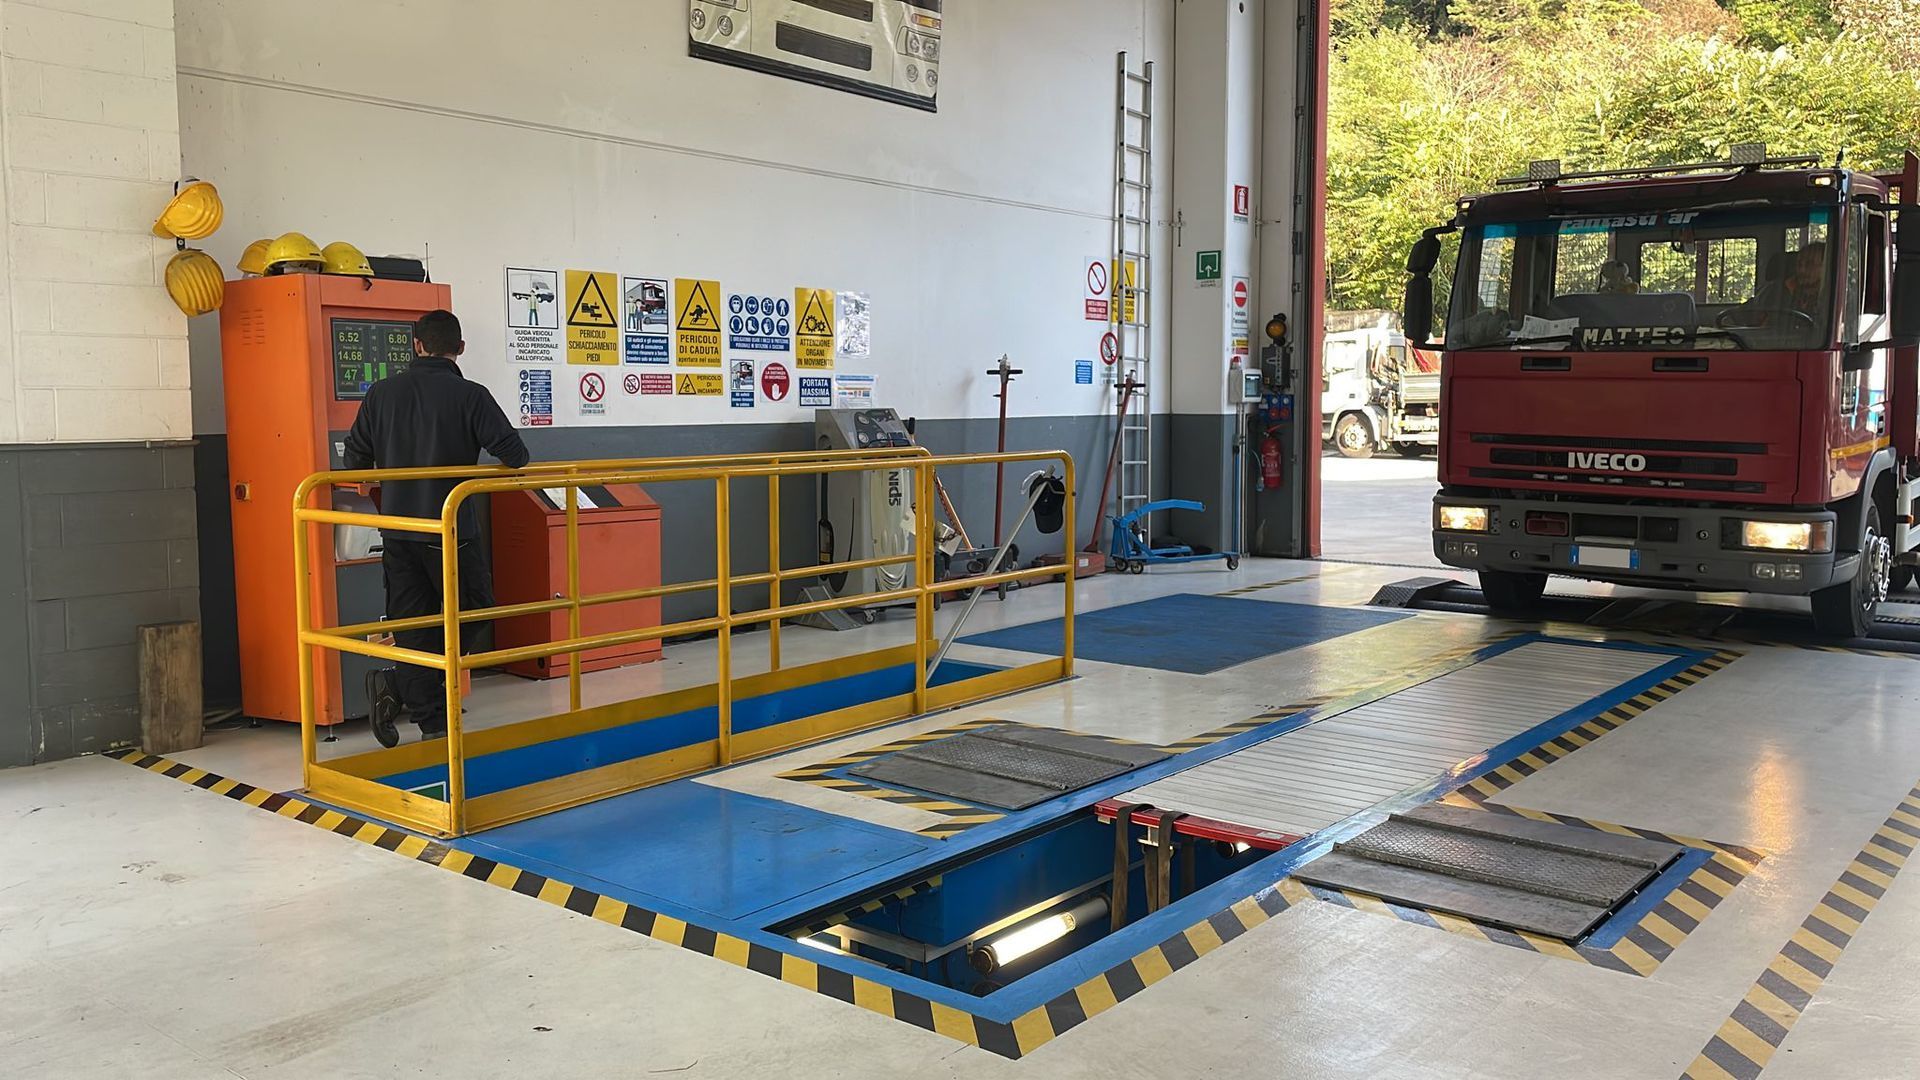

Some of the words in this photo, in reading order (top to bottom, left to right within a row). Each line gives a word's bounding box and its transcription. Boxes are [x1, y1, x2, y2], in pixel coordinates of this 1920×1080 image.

[339, 332, 359, 342] 6.52
[388, 334, 407, 344] 6.80
[580, 329, 606, 339] PERICOLO
[680, 334, 717, 344] PERICOLO
[1582, 327, 1685, 345] MATTEO
[568, 341, 616, 351] SCHIACCIAMENTO
[800, 339, 830, 348] ATTENZIONE
[338, 351, 362, 360] 14.68
[680, 346, 687, 354] DI
[690, 346, 719, 355] CADUTA
[388, 353, 410, 362] 13.50
[586, 353, 600, 362] PIEDI
[344, 369, 357, 380] 47
[801, 388, 829, 396] MASSIMA
[1568, 452, 1646, 472] IVECO
